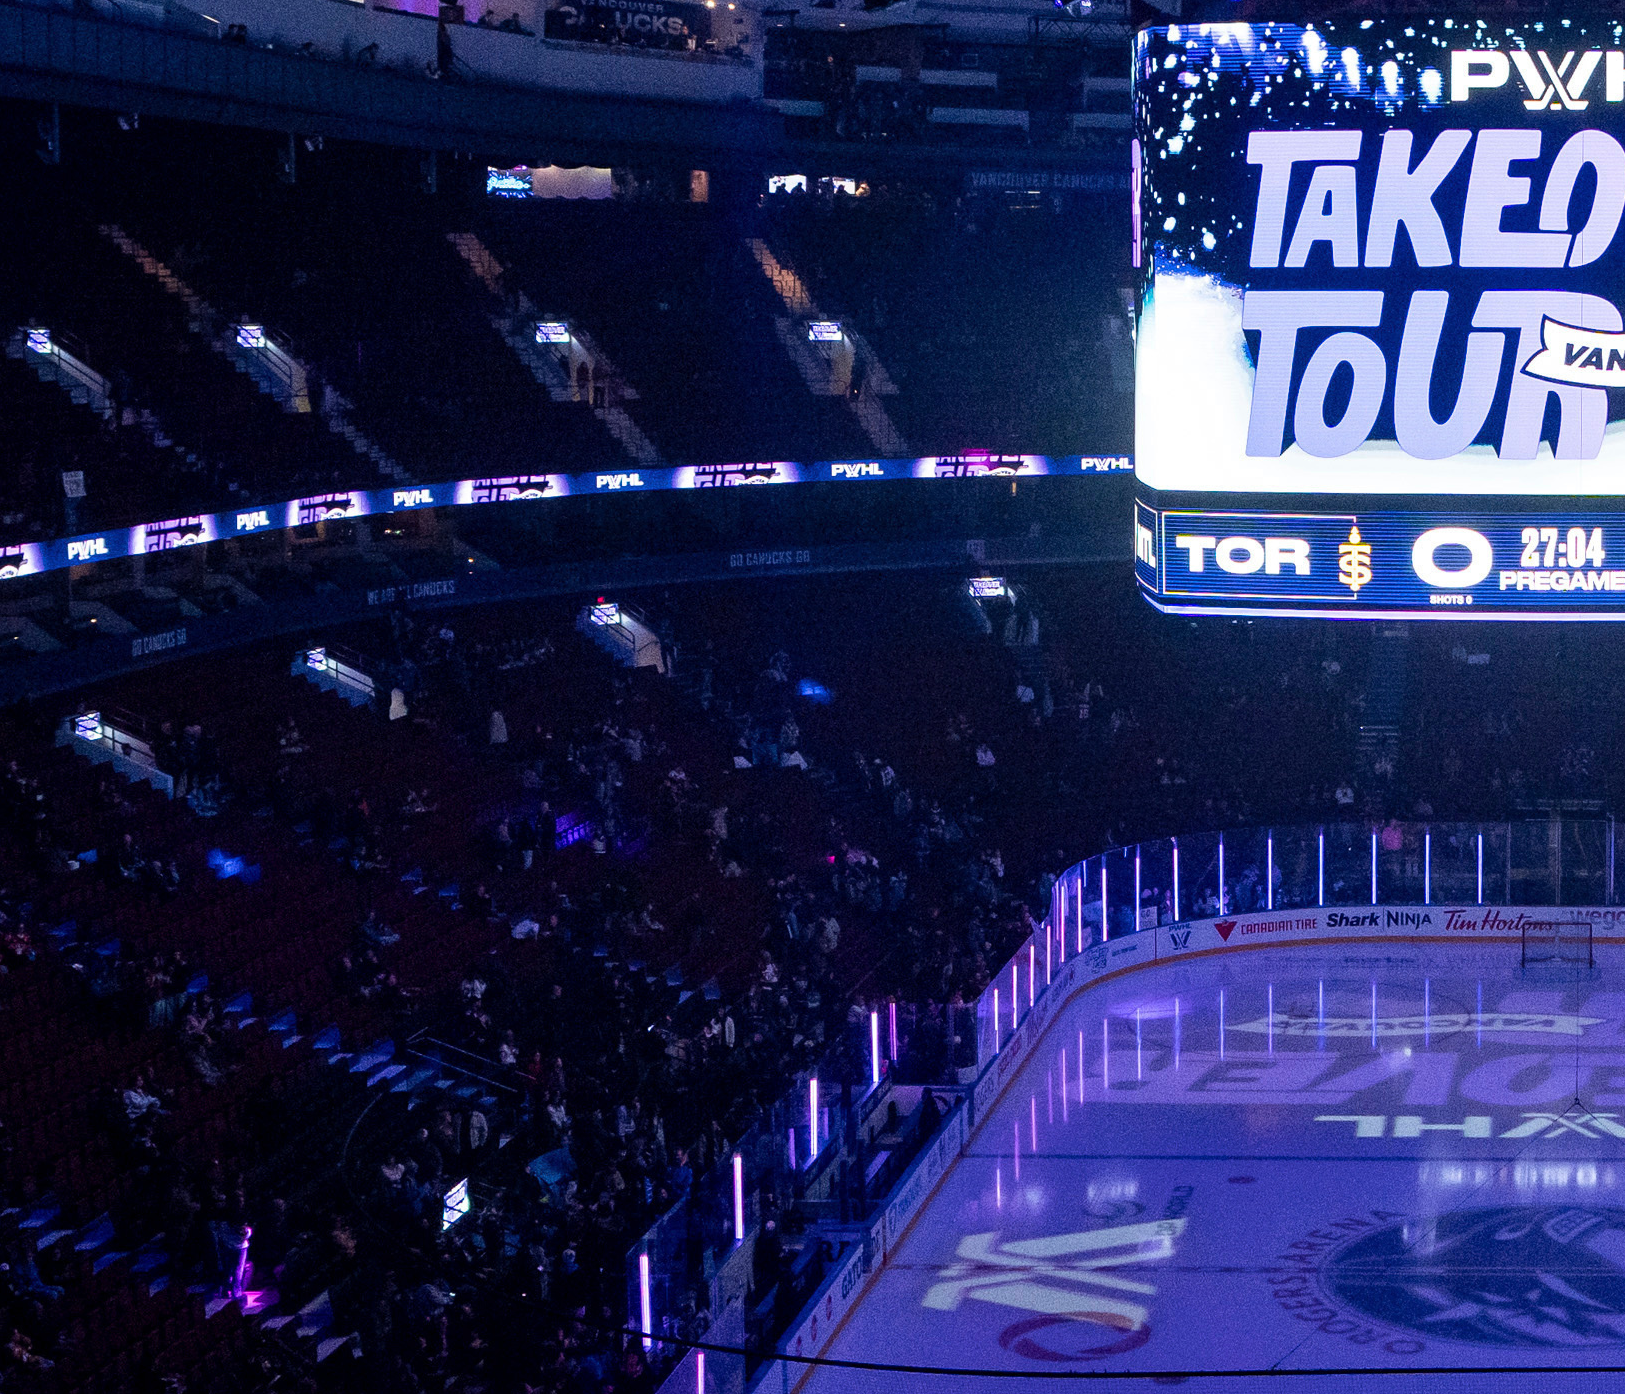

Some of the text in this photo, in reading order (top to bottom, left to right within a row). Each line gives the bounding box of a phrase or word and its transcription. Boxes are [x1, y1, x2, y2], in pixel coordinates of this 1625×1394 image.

[1241, 290, 1625, 461] TOUR
[831, 462, 885, 478] PWHL
[1081, 457, 1134, 472] PWHL
[596, 473, 645, 490] PWHL
[393, 488, 434, 507] PWHL
[235, 510, 270, 531] PWHL
[66, 537, 109, 561] PWHL
[1176, 536, 1310, 575] TOR
[1520, 527, 1606, 568] 27:04
[1429, 595, 1461, 605] SHOTS
[1240, 917, 1318, 936] CANADIAN TIRE
[1325, 911, 1433, 928] Shark NINJA
[1444, 909, 1478, 932] Tim
